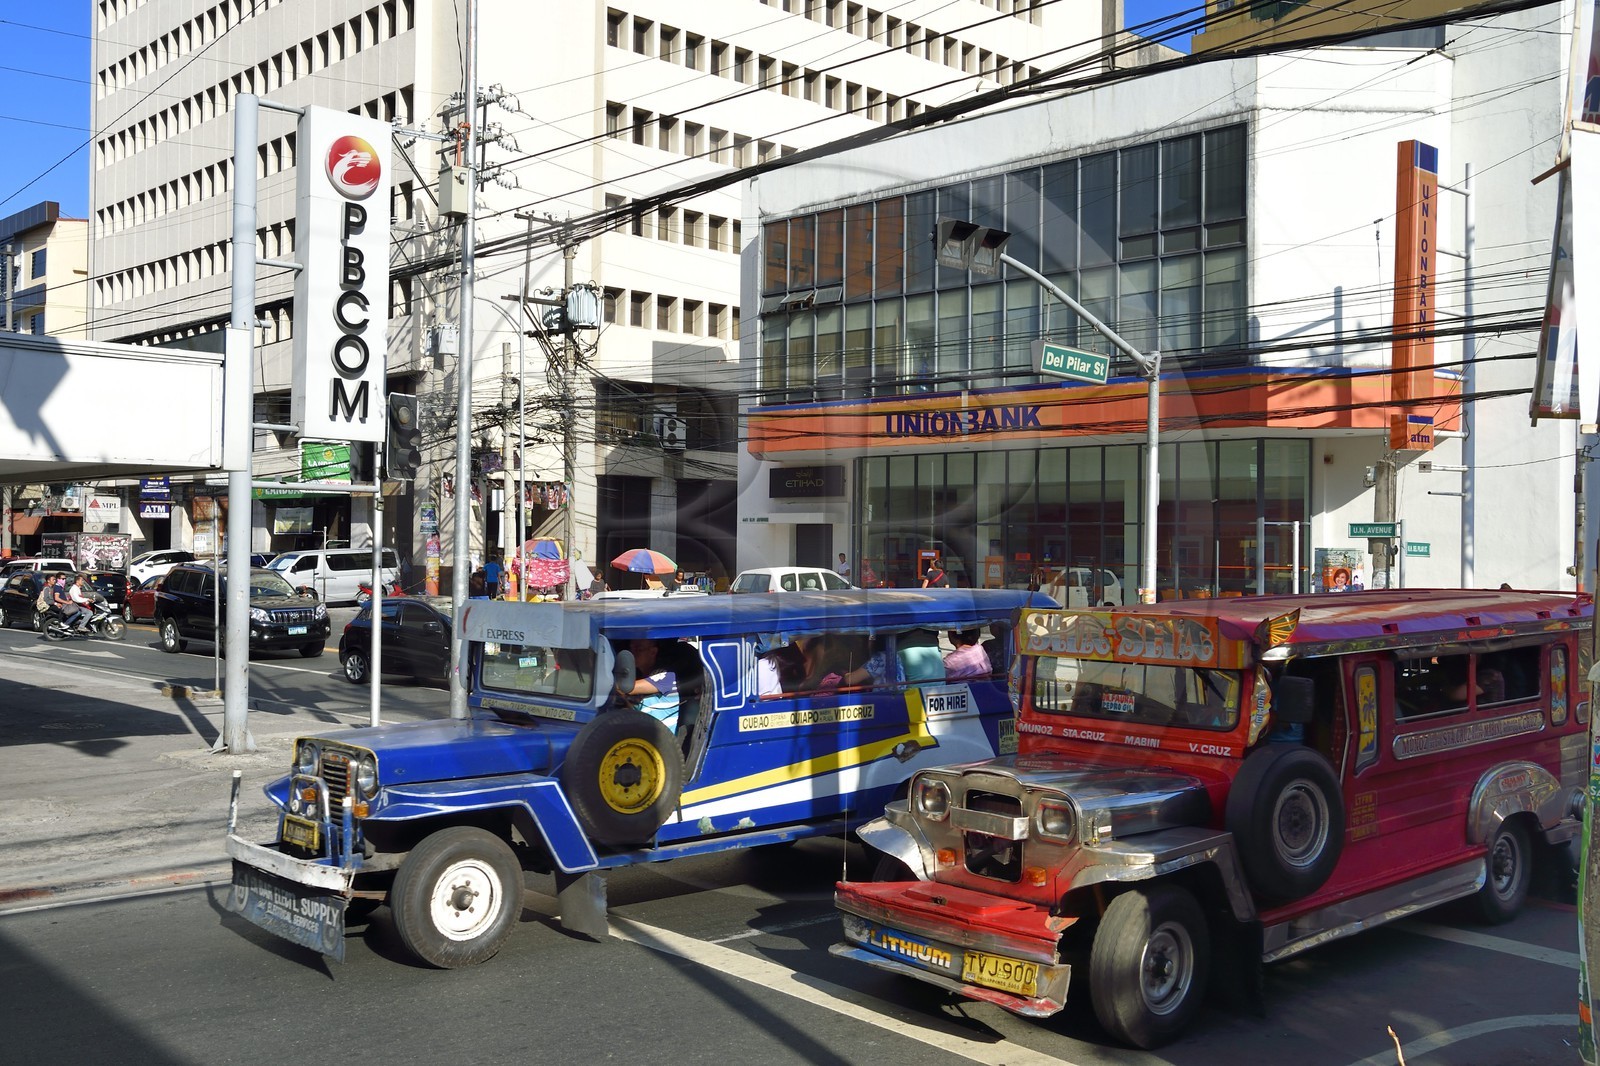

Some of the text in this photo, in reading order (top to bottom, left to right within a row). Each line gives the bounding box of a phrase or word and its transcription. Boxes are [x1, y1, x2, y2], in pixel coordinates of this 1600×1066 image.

[1418, 184, 1429, 343] UNIONBANK
[328, 201, 370, 424] PBCOM
[1045, 351, 1105, 376] Del Pilar St
[886, 405, 1042, 438] UNIONBANK
[1411, 433, 1430, 443] atm
[785, 478, 825, 488] ETIHAD
[145, 505, 166, 513] ATM
[1367, 526, 1393, 534] AVENUE
[486, 628, 525, 642] EXPRESS
[929, 695, 966, 712] FOR HIRE
[742, 715, 769, 730] CUBAO
[790, 711, 819, 725] QUIAPO
[834, 707, 851, 721] VITO
[853, 706, 873, 719] CRUZ
[1124, 735, 1160, 748] MABINI
[1200, 744, 1231, 756] CRUZ
[301, 897, 339, 927] SUPPLY
[870, 929, 952, 968] LITHIUM
